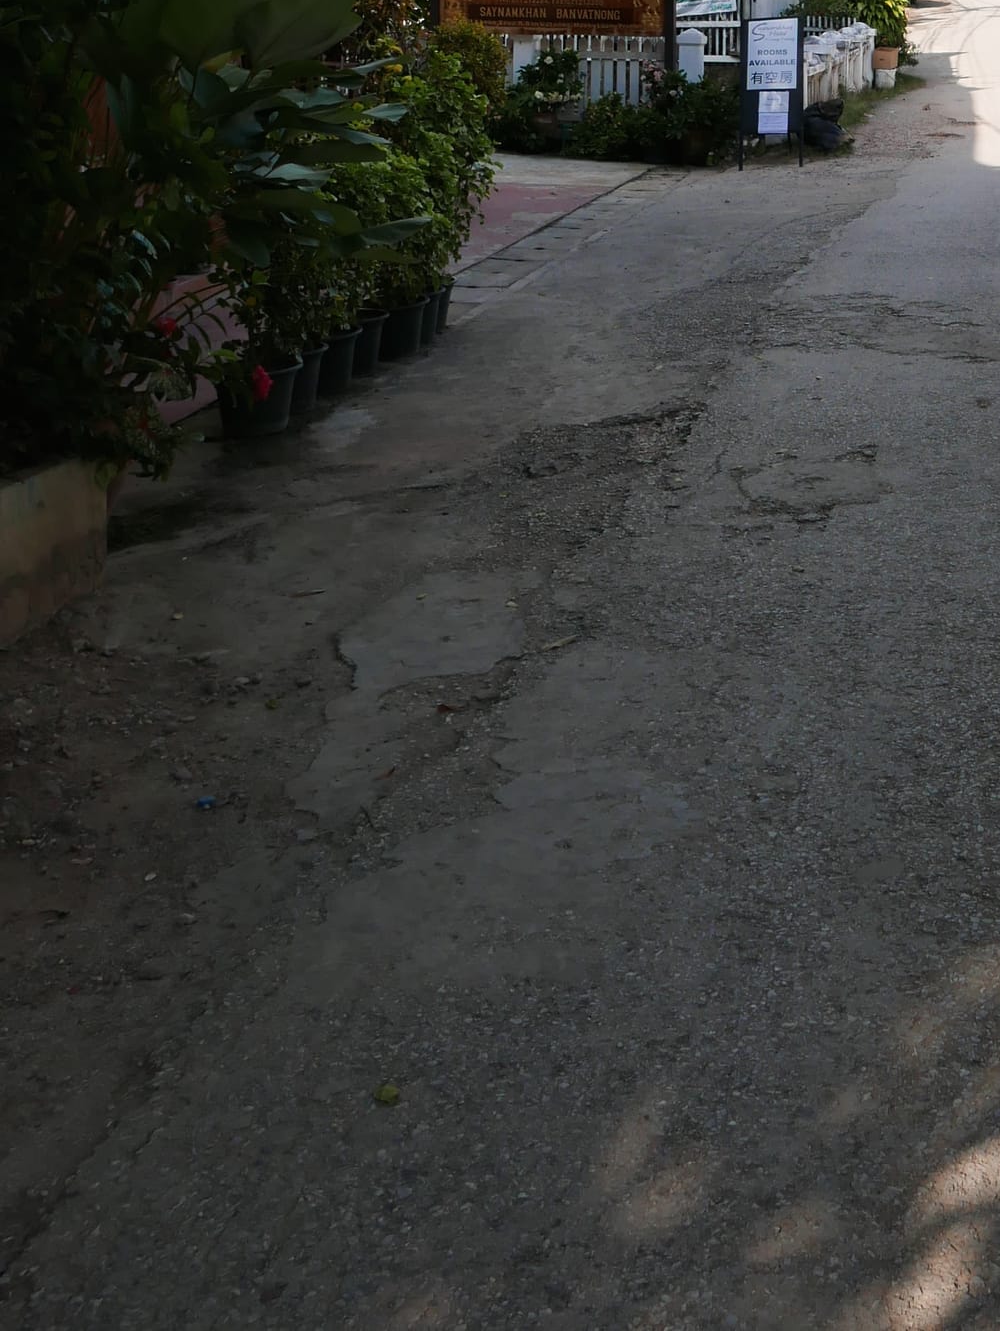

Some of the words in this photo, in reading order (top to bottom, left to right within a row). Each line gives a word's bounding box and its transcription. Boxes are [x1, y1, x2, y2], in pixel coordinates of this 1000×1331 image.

[479, 6, 547, 18] SAYNAMKHAN
[749, 59, 796, 67] AVAILABLE
[751, 70, 793, 85] 有空房
